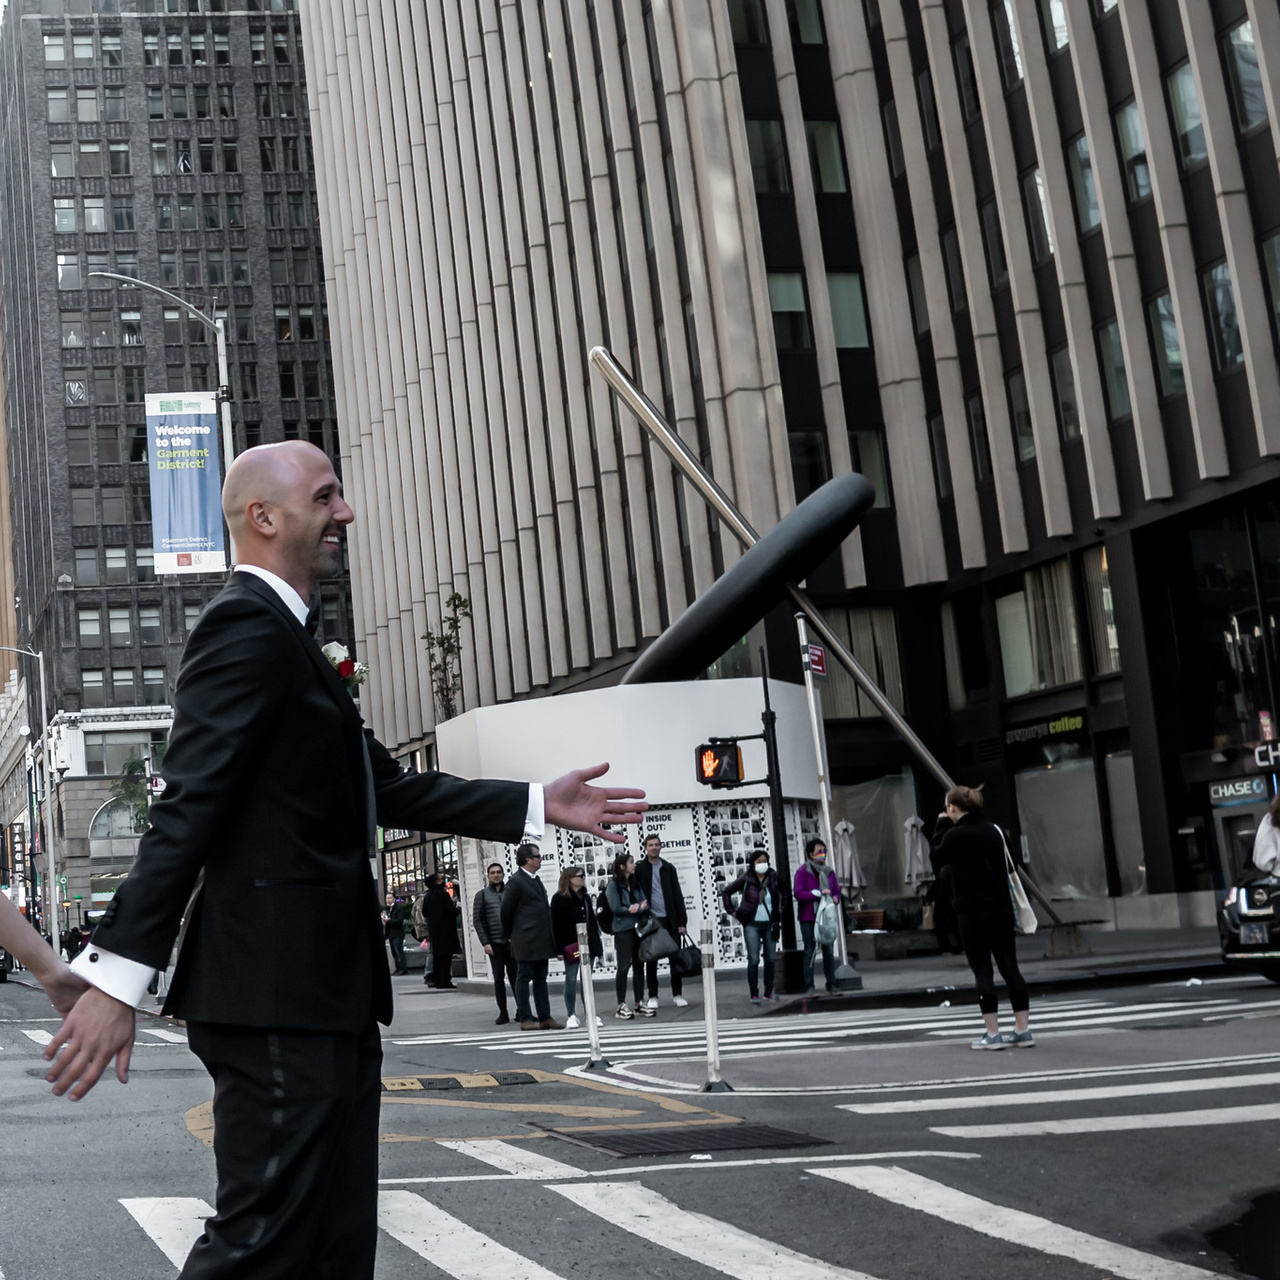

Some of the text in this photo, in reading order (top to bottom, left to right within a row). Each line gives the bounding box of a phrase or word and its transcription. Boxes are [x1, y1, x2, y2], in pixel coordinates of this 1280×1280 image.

[155, 425, 211, 436] Welcome
[155, 436, 192, 448] to the
[156, 448, 210, 459] Garment
[157, 459, 205, 470] District!
[1049, 715, 1083, 734] coffee
[1211, 780, 1253, 799] CHASE
[645, 814, 672, 823] INSIDE
[646, 824, 667, 832] OUT:
[661, 839, 692, 848] GETHER
